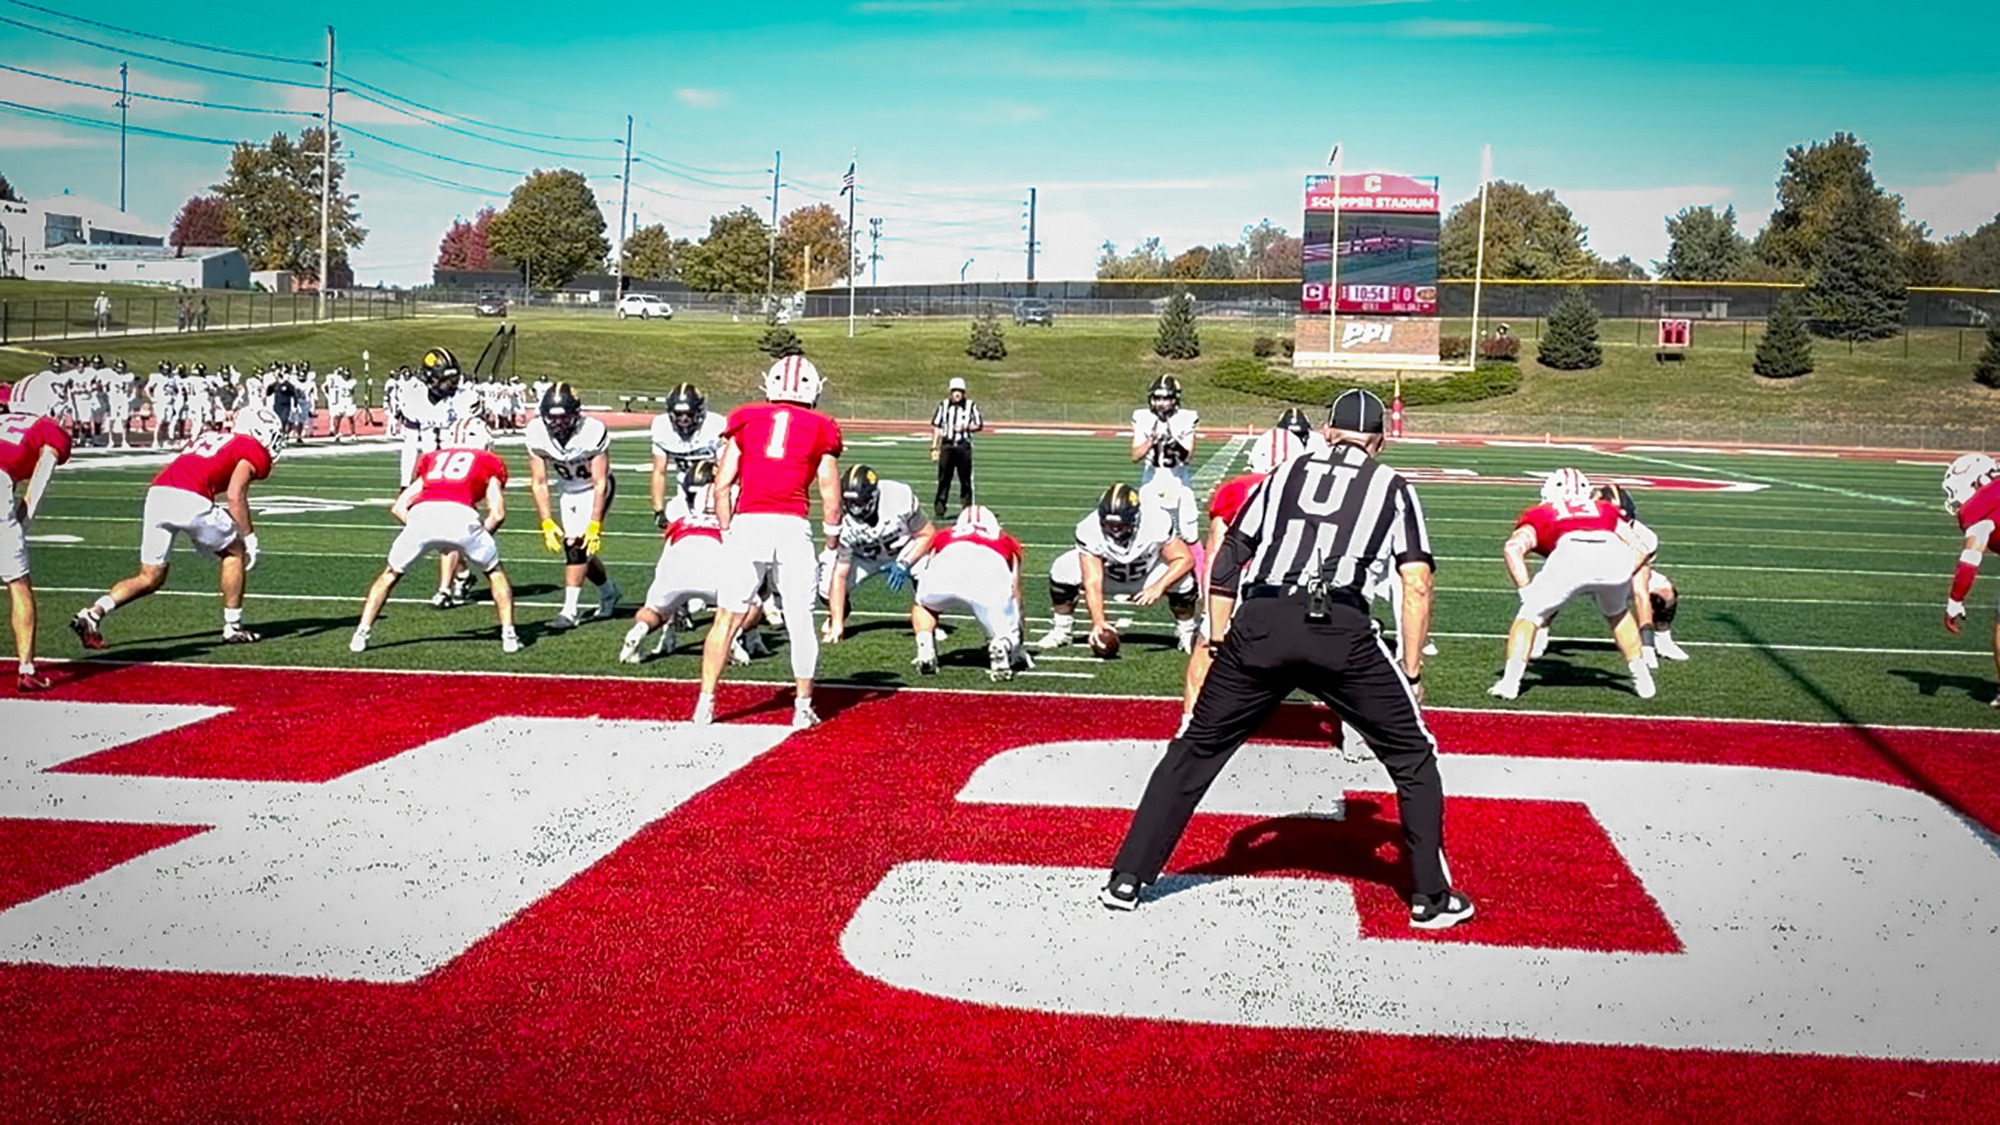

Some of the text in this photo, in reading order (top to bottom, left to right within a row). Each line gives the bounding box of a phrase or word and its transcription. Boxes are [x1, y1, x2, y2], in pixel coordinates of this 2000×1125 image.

[1364, 175, 1381, 193] C
[1311, 196, 1435, 209] SCHPPER STADIUM
[1341, 323, 1393, 348] PPI
[765, 410, 790, 459] 1
[426, 451, 476, 480] 18
[1297, 461, 1359, 517] U
